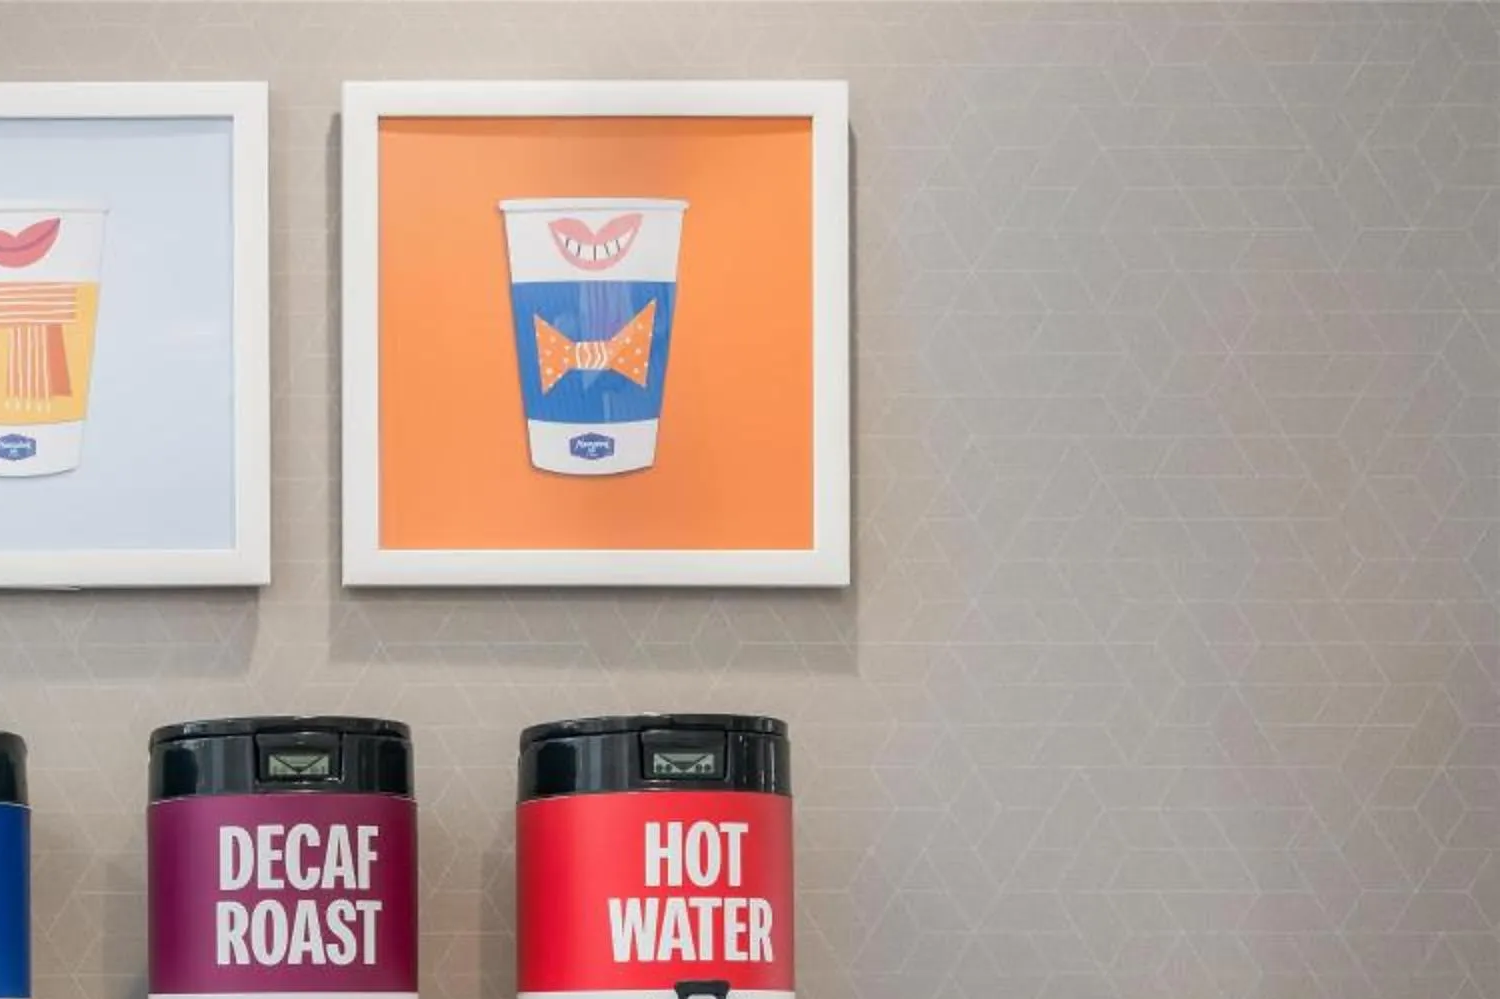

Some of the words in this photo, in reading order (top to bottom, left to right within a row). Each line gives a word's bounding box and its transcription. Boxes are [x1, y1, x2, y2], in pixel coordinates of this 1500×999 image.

[218, 824, 380, 891] DECAF
[644, 821, 749, 888] HOT
[215, 899, 382, 966] ROAST
[608, 897, 774, 963] WATER
